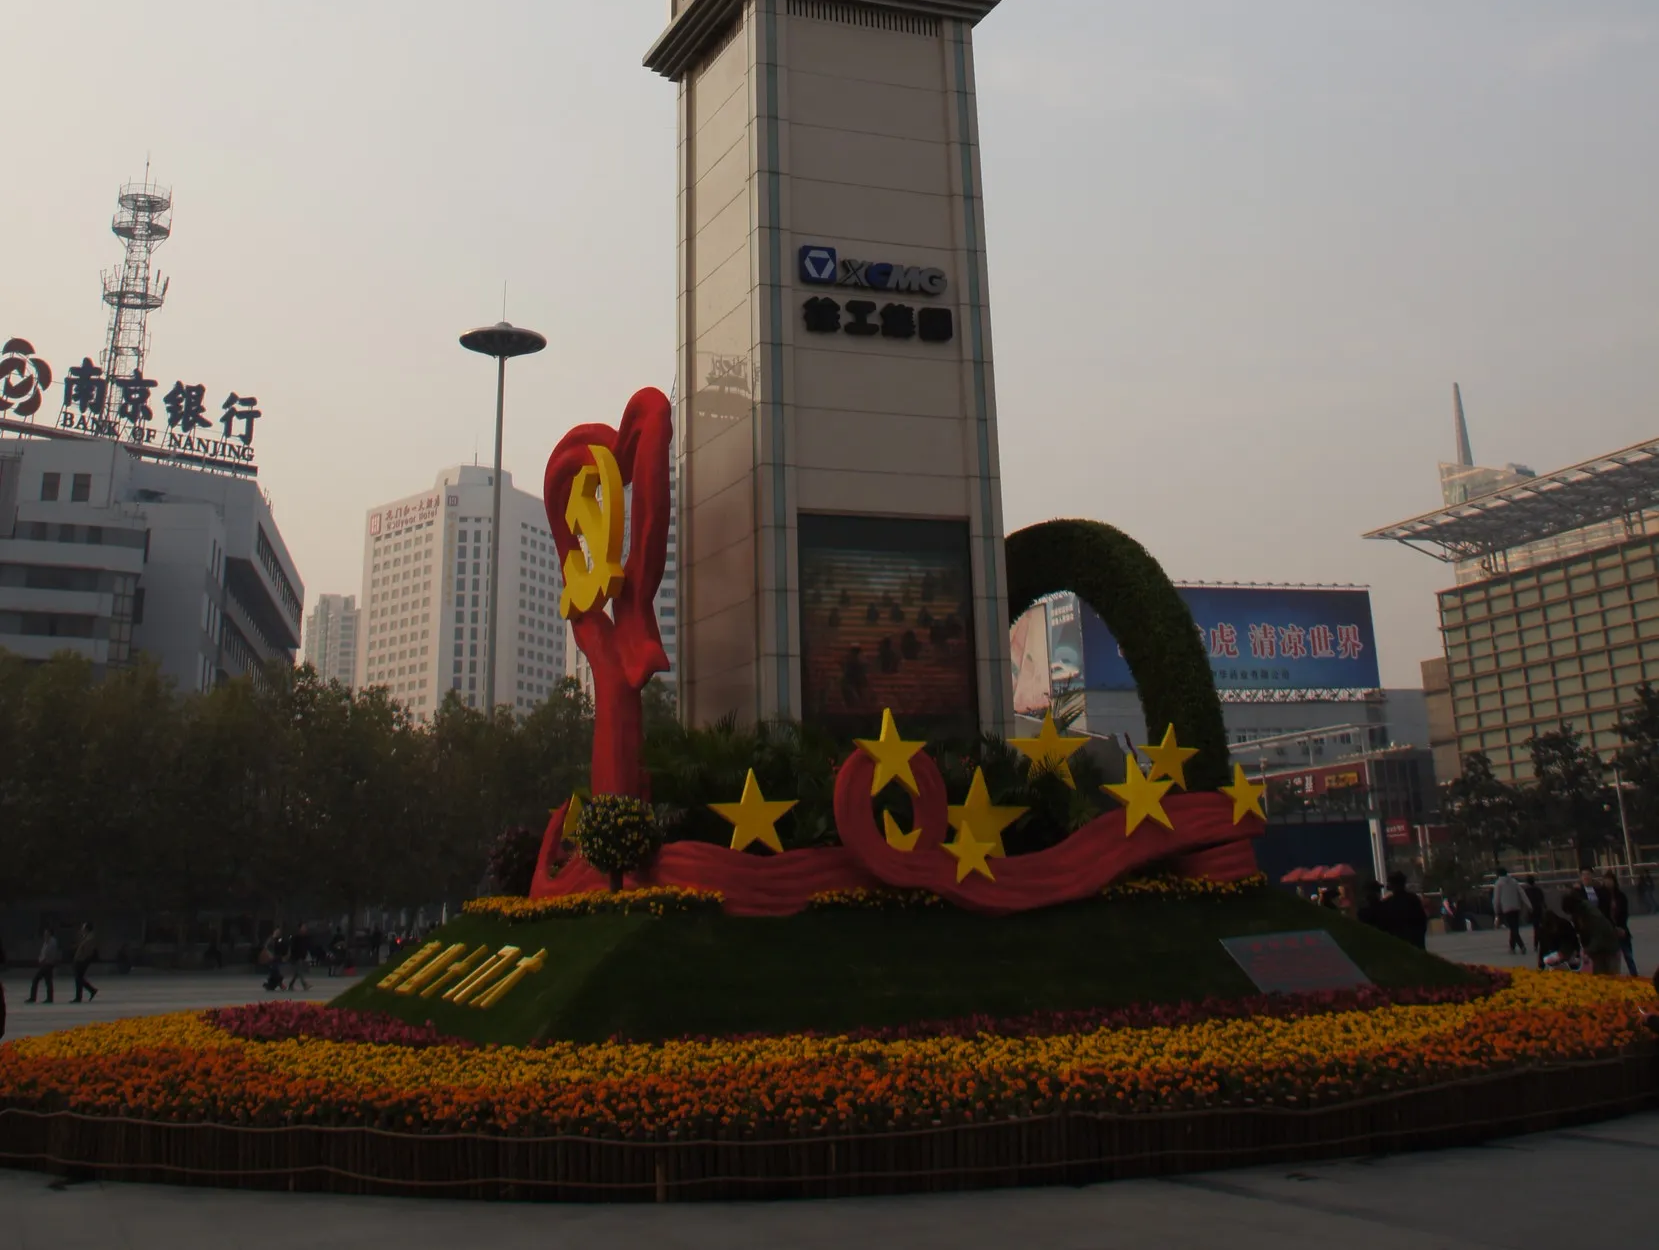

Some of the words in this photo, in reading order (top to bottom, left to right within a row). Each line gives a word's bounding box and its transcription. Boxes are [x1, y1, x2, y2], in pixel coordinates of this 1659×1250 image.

[838, 258, 948, 295] XCMG
[63, 356, 262, 446] 南京银行
[61, 411, 120, 437] BANK
[132, 426, 157, 444] OF
[169, 432, 256, 462] NANJING
[1248, 622, 1363, 660] 清凉世界
